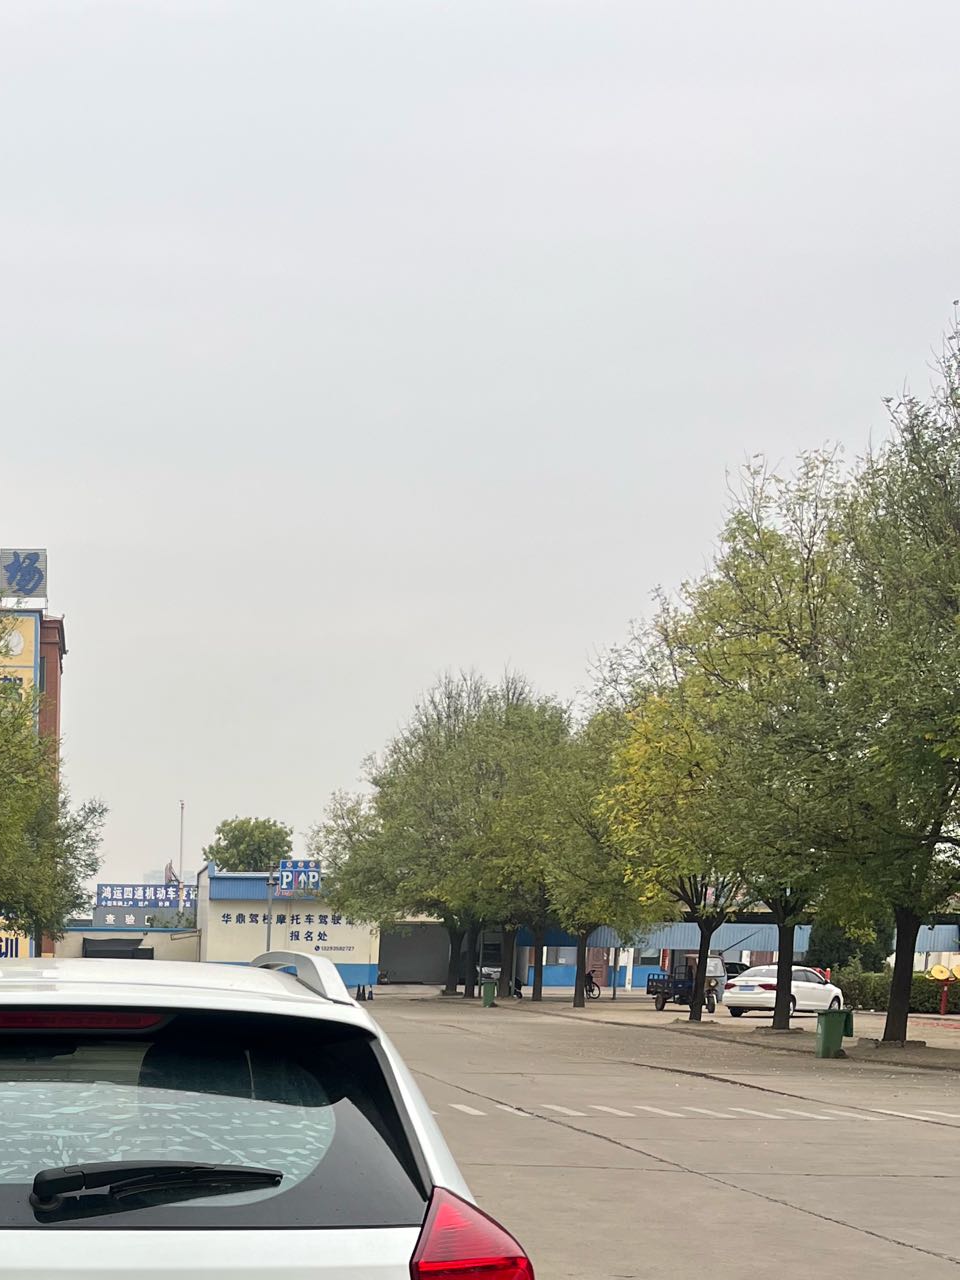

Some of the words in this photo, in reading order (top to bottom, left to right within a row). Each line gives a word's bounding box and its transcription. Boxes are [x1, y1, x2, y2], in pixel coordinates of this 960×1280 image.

[281, 871, 293, 889] P
[308, 871, 319, 889] P
[290, 931, 328, 942] 报名处
